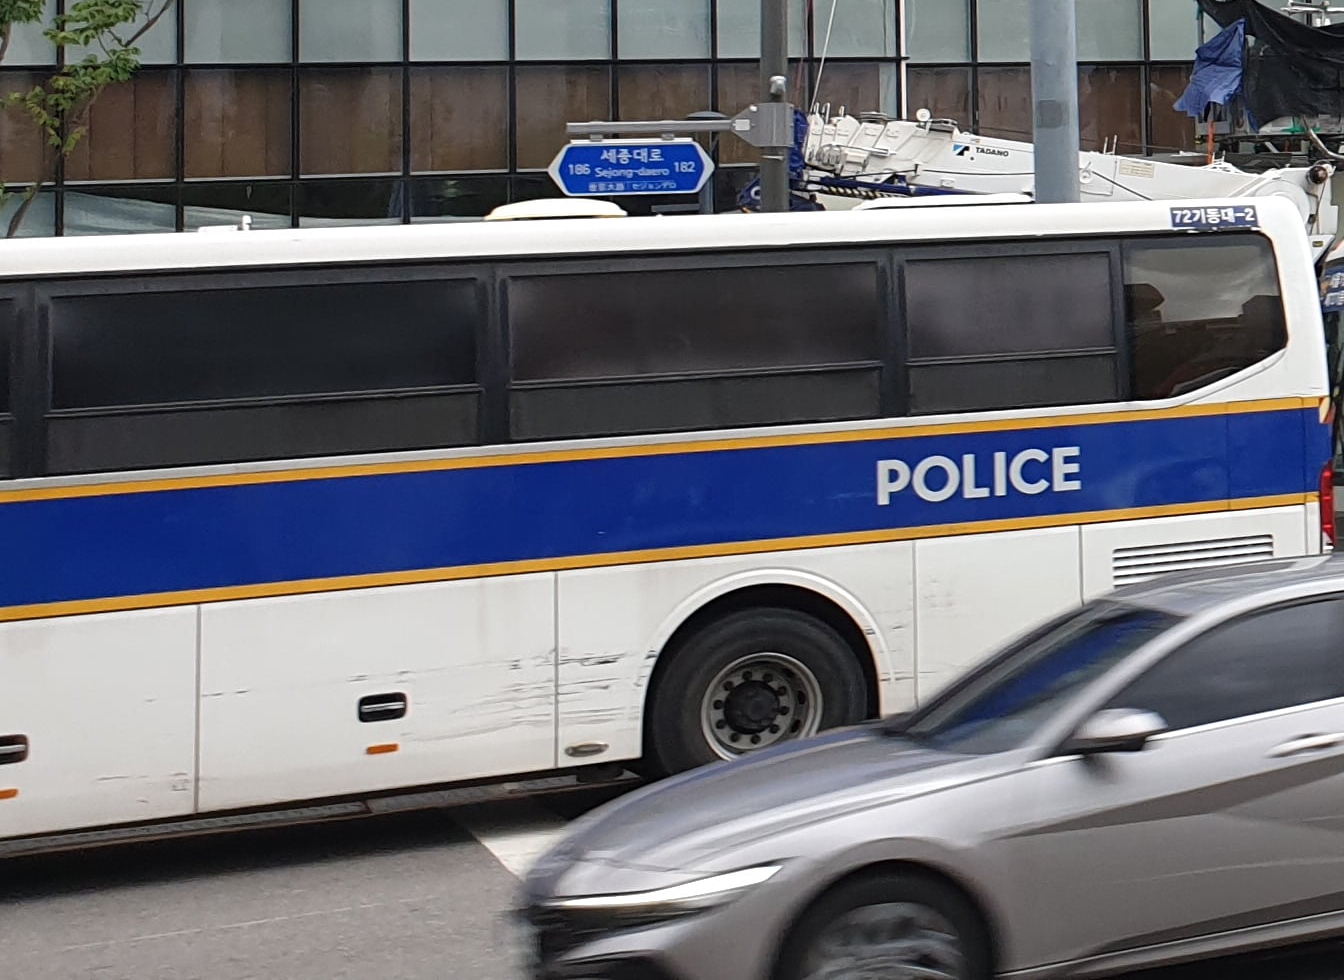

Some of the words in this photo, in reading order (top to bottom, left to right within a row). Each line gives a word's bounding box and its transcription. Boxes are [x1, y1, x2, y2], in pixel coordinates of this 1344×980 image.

[600, 148, 664, 164] 세종대로
[975, 146, 1009, 157] TADANO
[568, 164, 591, 175] 186
[594, 167, 670, 178] Sejong-daero
[674, 161, 696, 173] 182
[1172, 207, 1256, 224] 72기동대-2
[877, 446, 1082, 506] POLICE
